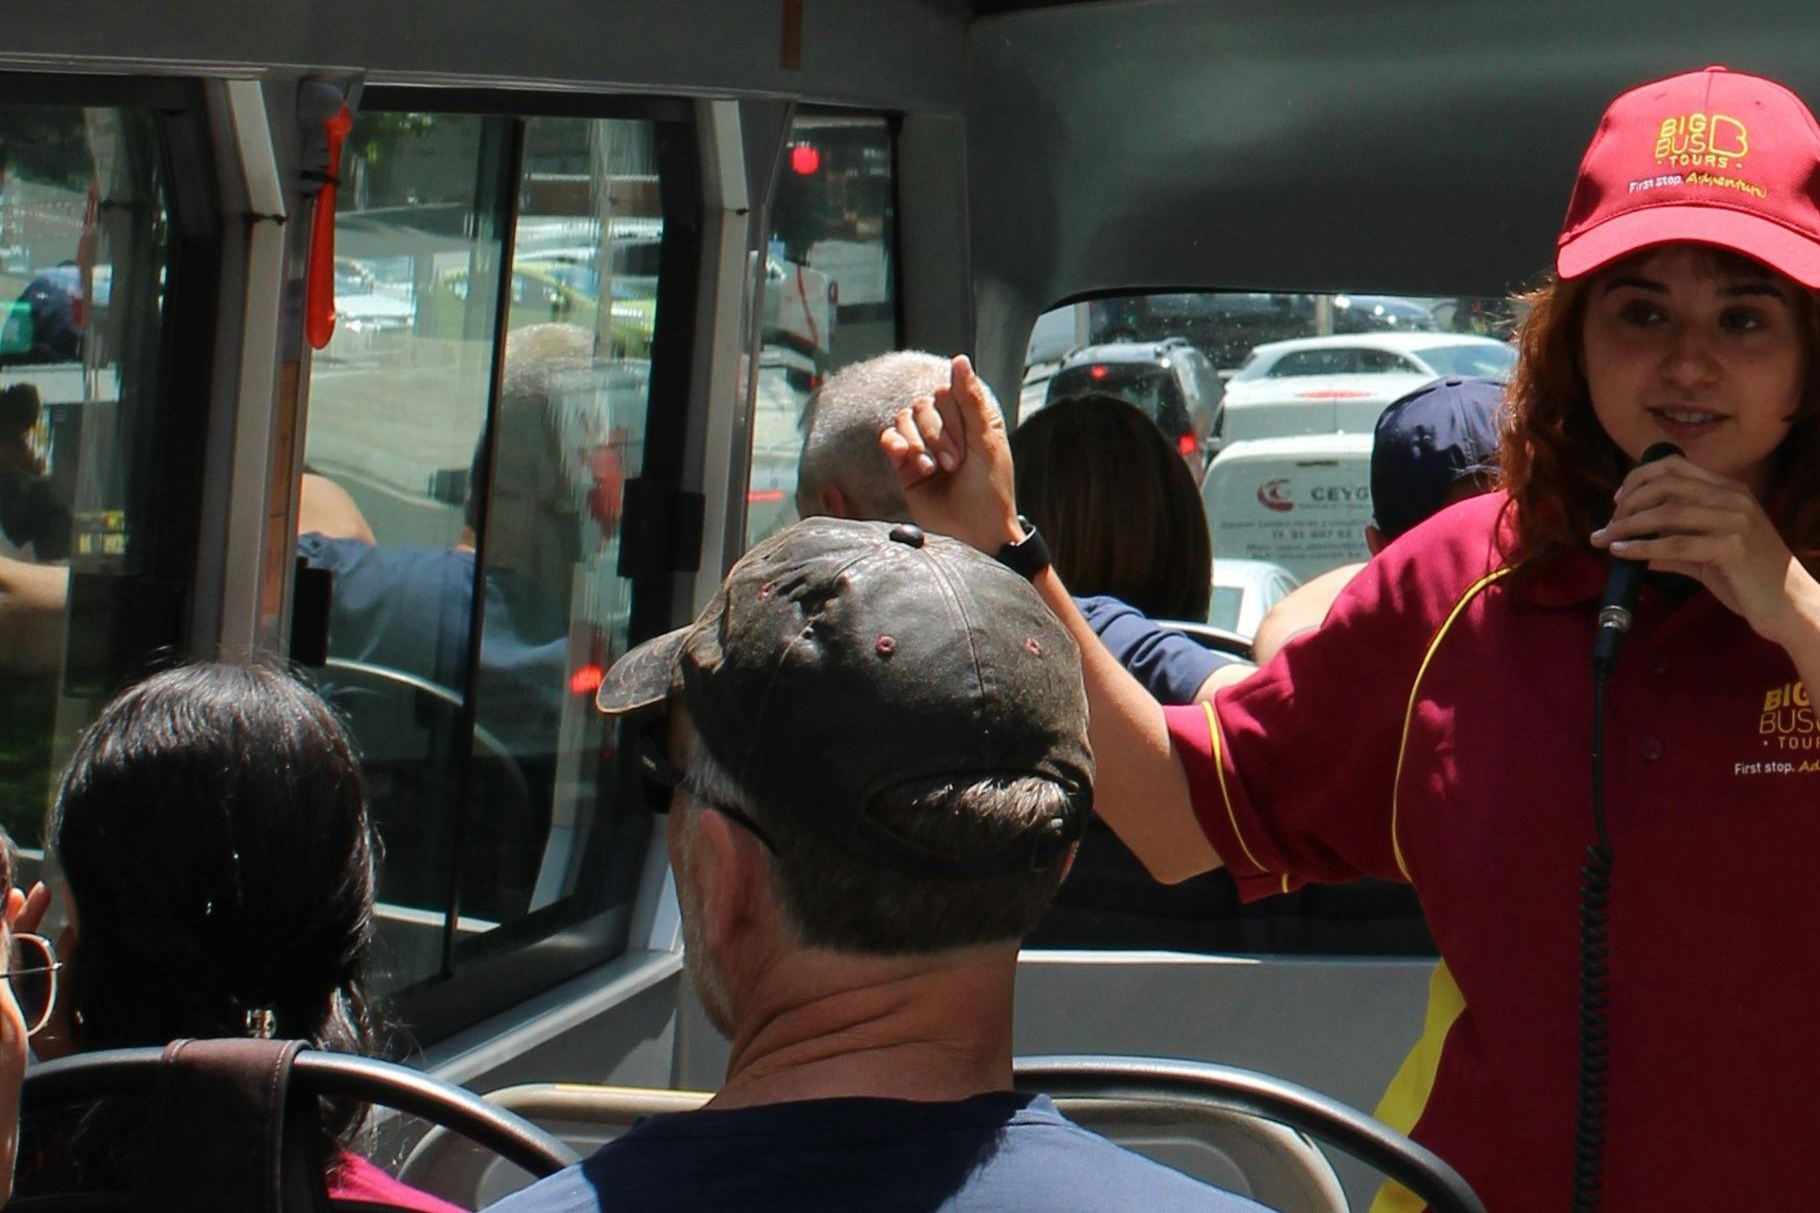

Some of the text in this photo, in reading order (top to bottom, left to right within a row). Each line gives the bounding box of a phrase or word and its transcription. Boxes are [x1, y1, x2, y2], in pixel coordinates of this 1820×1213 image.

[1660, 113, 1707, 138] BIG
[1655, 134, 1707, 158] BUS
[1669, 154, 1729, 169] TOURS
[1628, 178, 1654, 194] First
[1759, 708, 1814, 734] BUS
[1734, 762, 1761, 775] First
[1764, 761, 1795, 774] stop.
